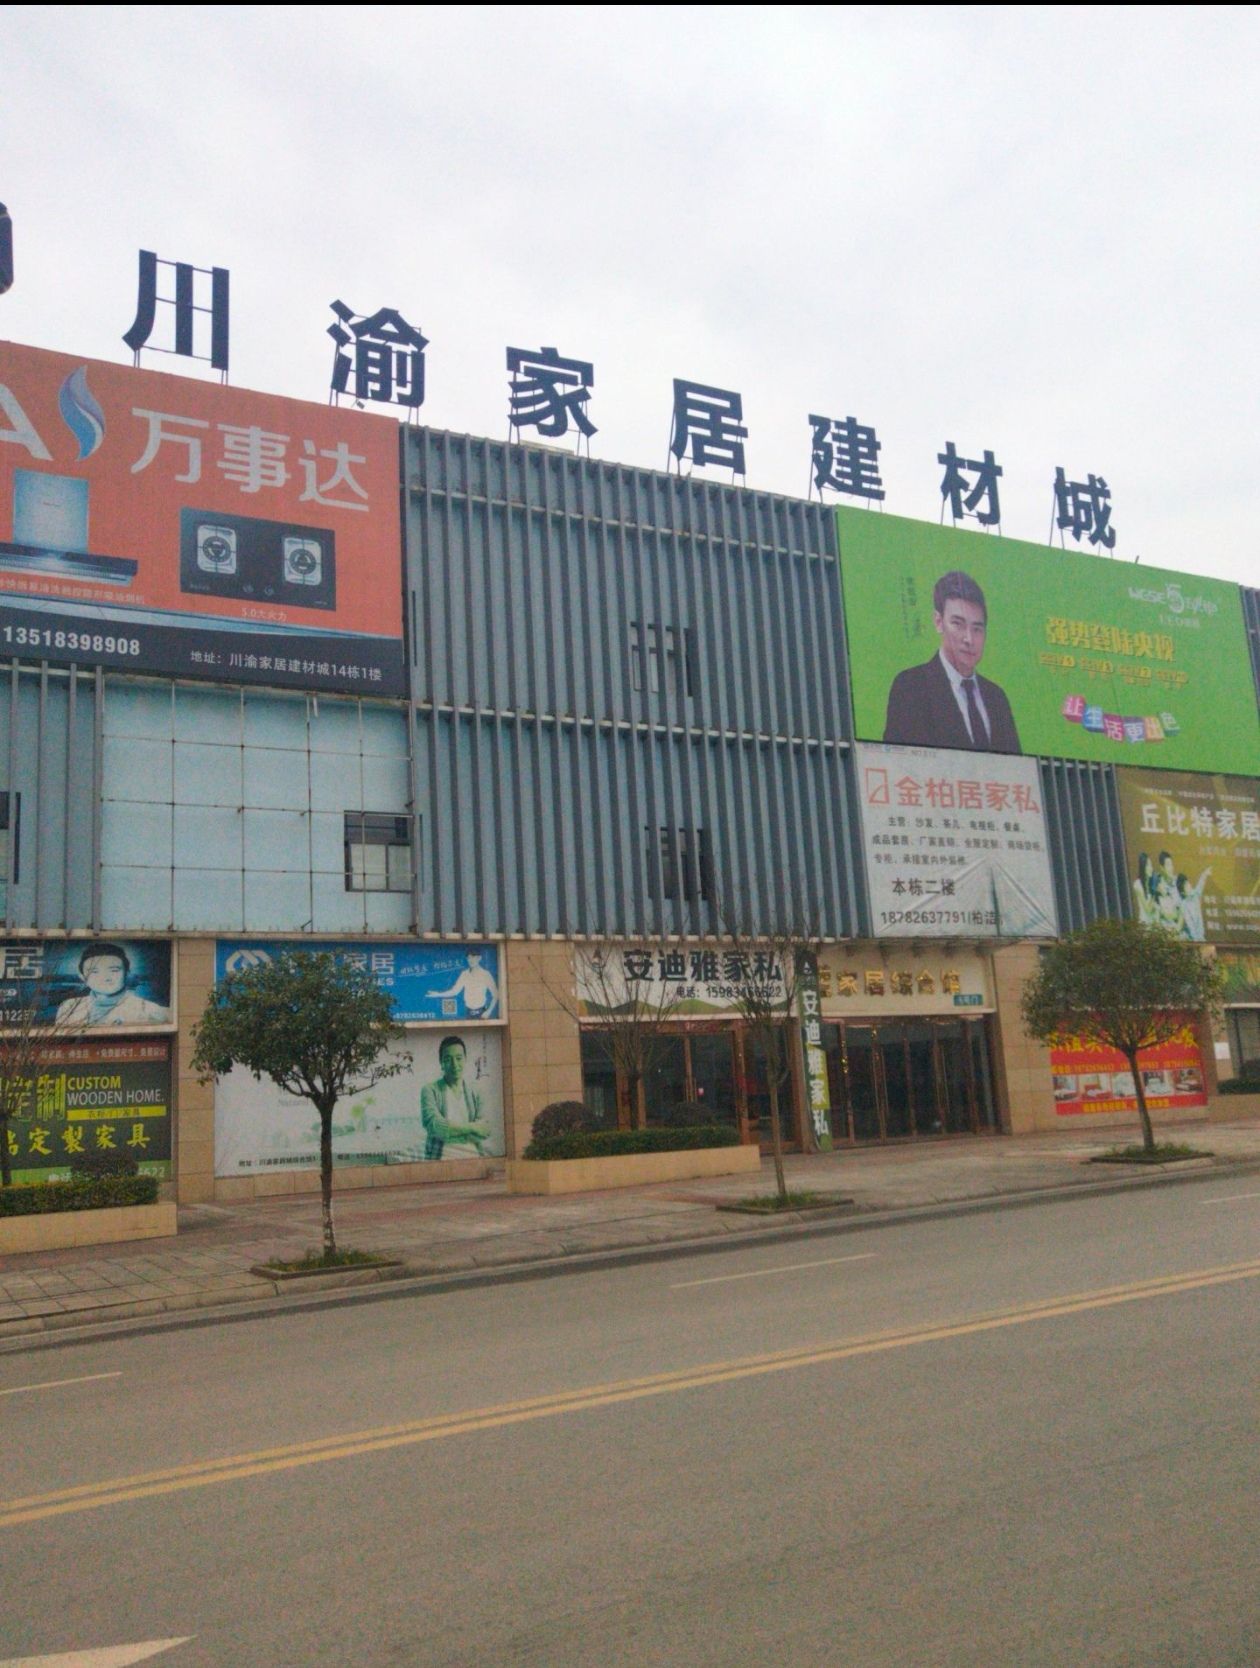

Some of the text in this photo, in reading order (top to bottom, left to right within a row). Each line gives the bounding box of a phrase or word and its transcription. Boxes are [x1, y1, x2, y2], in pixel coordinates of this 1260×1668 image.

[122, 249, 1116, 549] 川渝家居建材城
[131, 407, 369, 512] 万事达
[3, 626, 141, 656] 13518398908
[894, 775, 1041, 814] 金柏居家私
[1140, 802, 1260, 843] 丘比特家居
[892, 877, 956, 897] 本栋二楼
[624, 949, 783, 983] 安迪雅家私
[803, 990, 829, 1136] 安迪雅家私
[67, 1076, 122, 1091] CUSTOM
[67, 1091, 123, 1106] WOODEN
